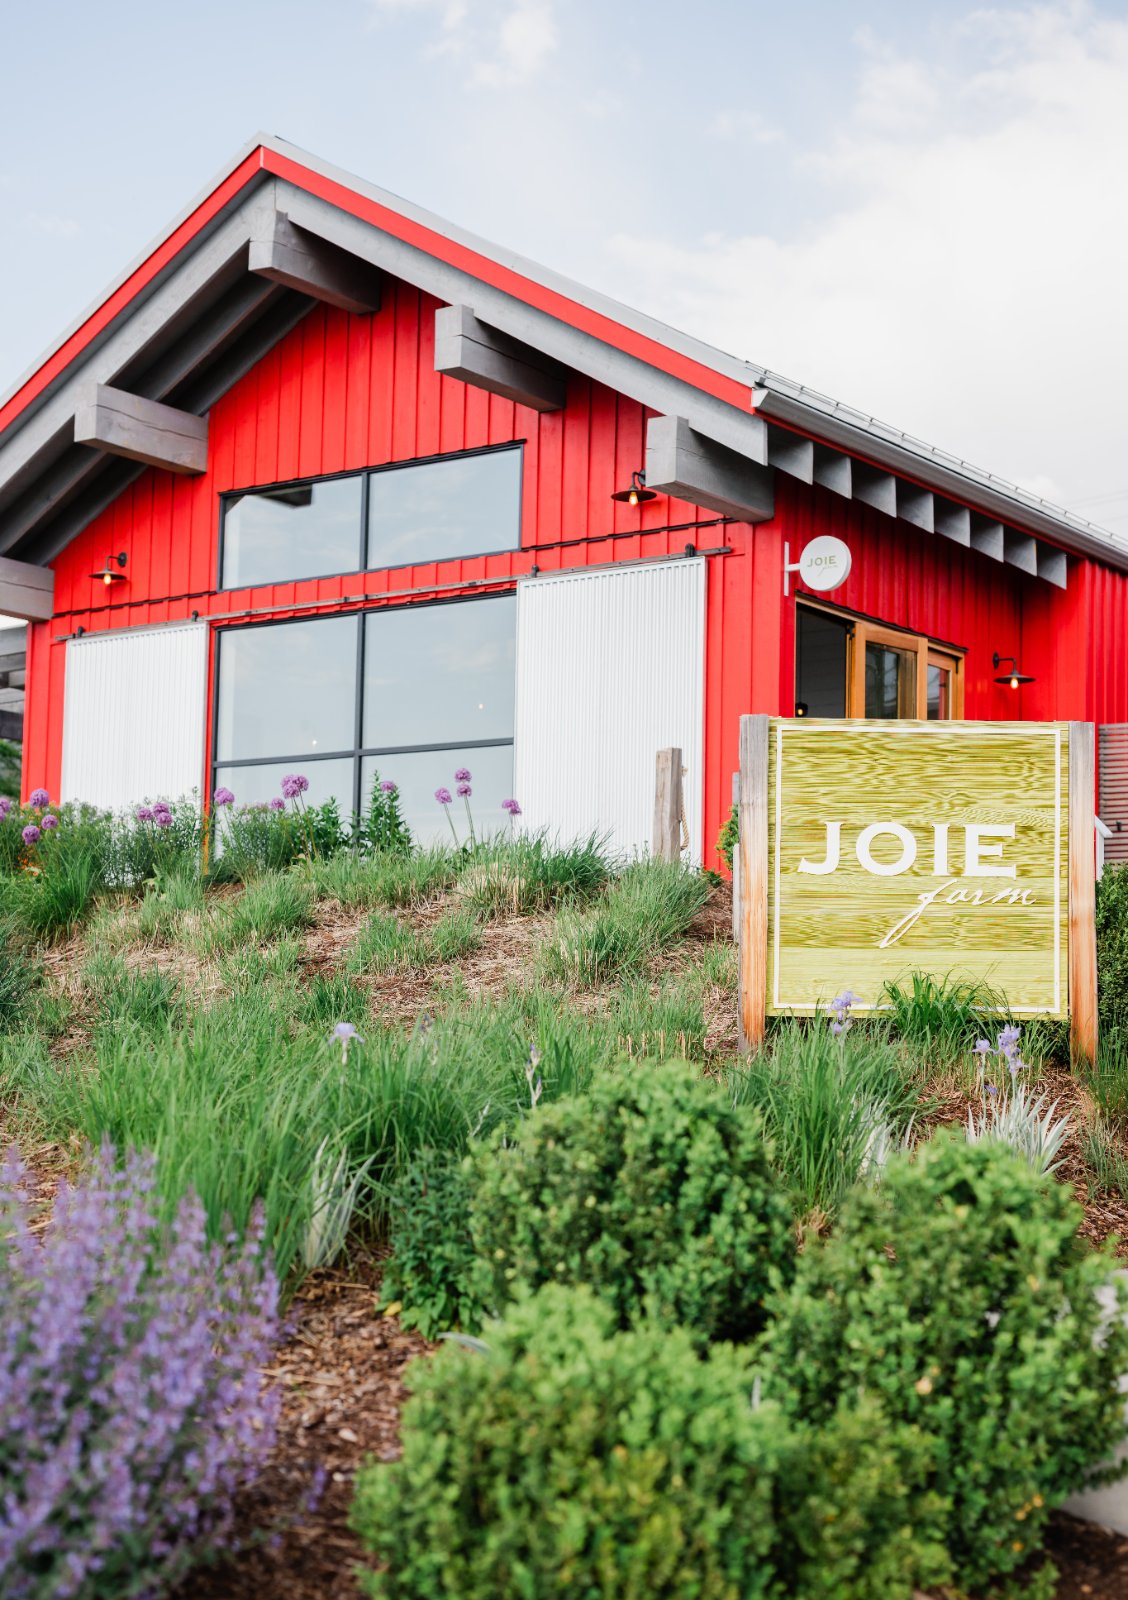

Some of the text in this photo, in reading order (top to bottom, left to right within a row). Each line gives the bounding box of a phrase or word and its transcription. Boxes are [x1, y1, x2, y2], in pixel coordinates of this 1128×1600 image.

[807, 555, 837, 568] JOIE
[797, 821, 1017, 880] JOIE
[880, 879, 1037, 949] farm
